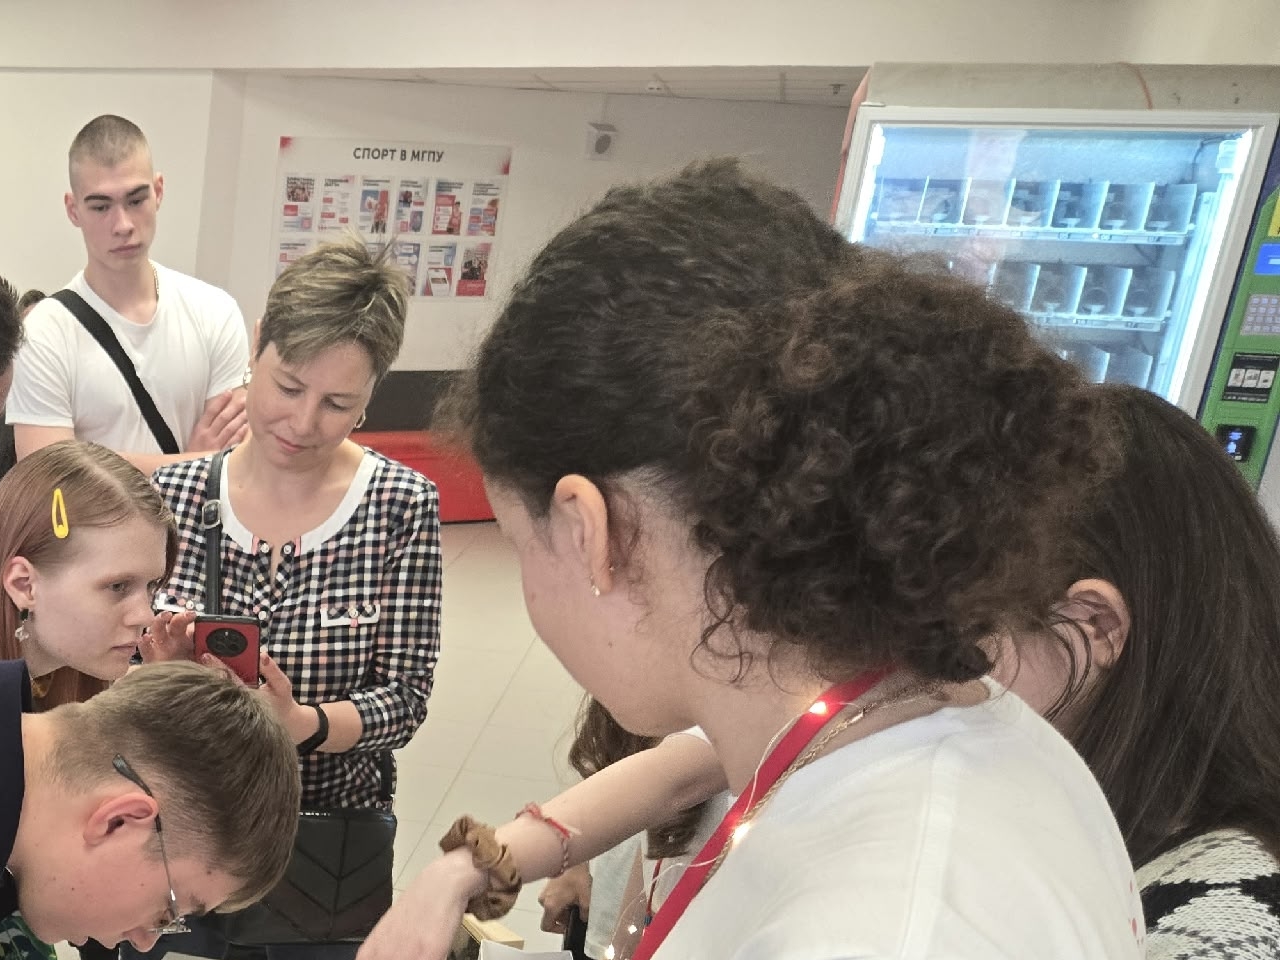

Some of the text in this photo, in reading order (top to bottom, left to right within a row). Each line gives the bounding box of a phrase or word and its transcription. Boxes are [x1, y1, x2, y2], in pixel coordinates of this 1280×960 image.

[353, 147, 445, 164] СПОРТ В МГПУ
